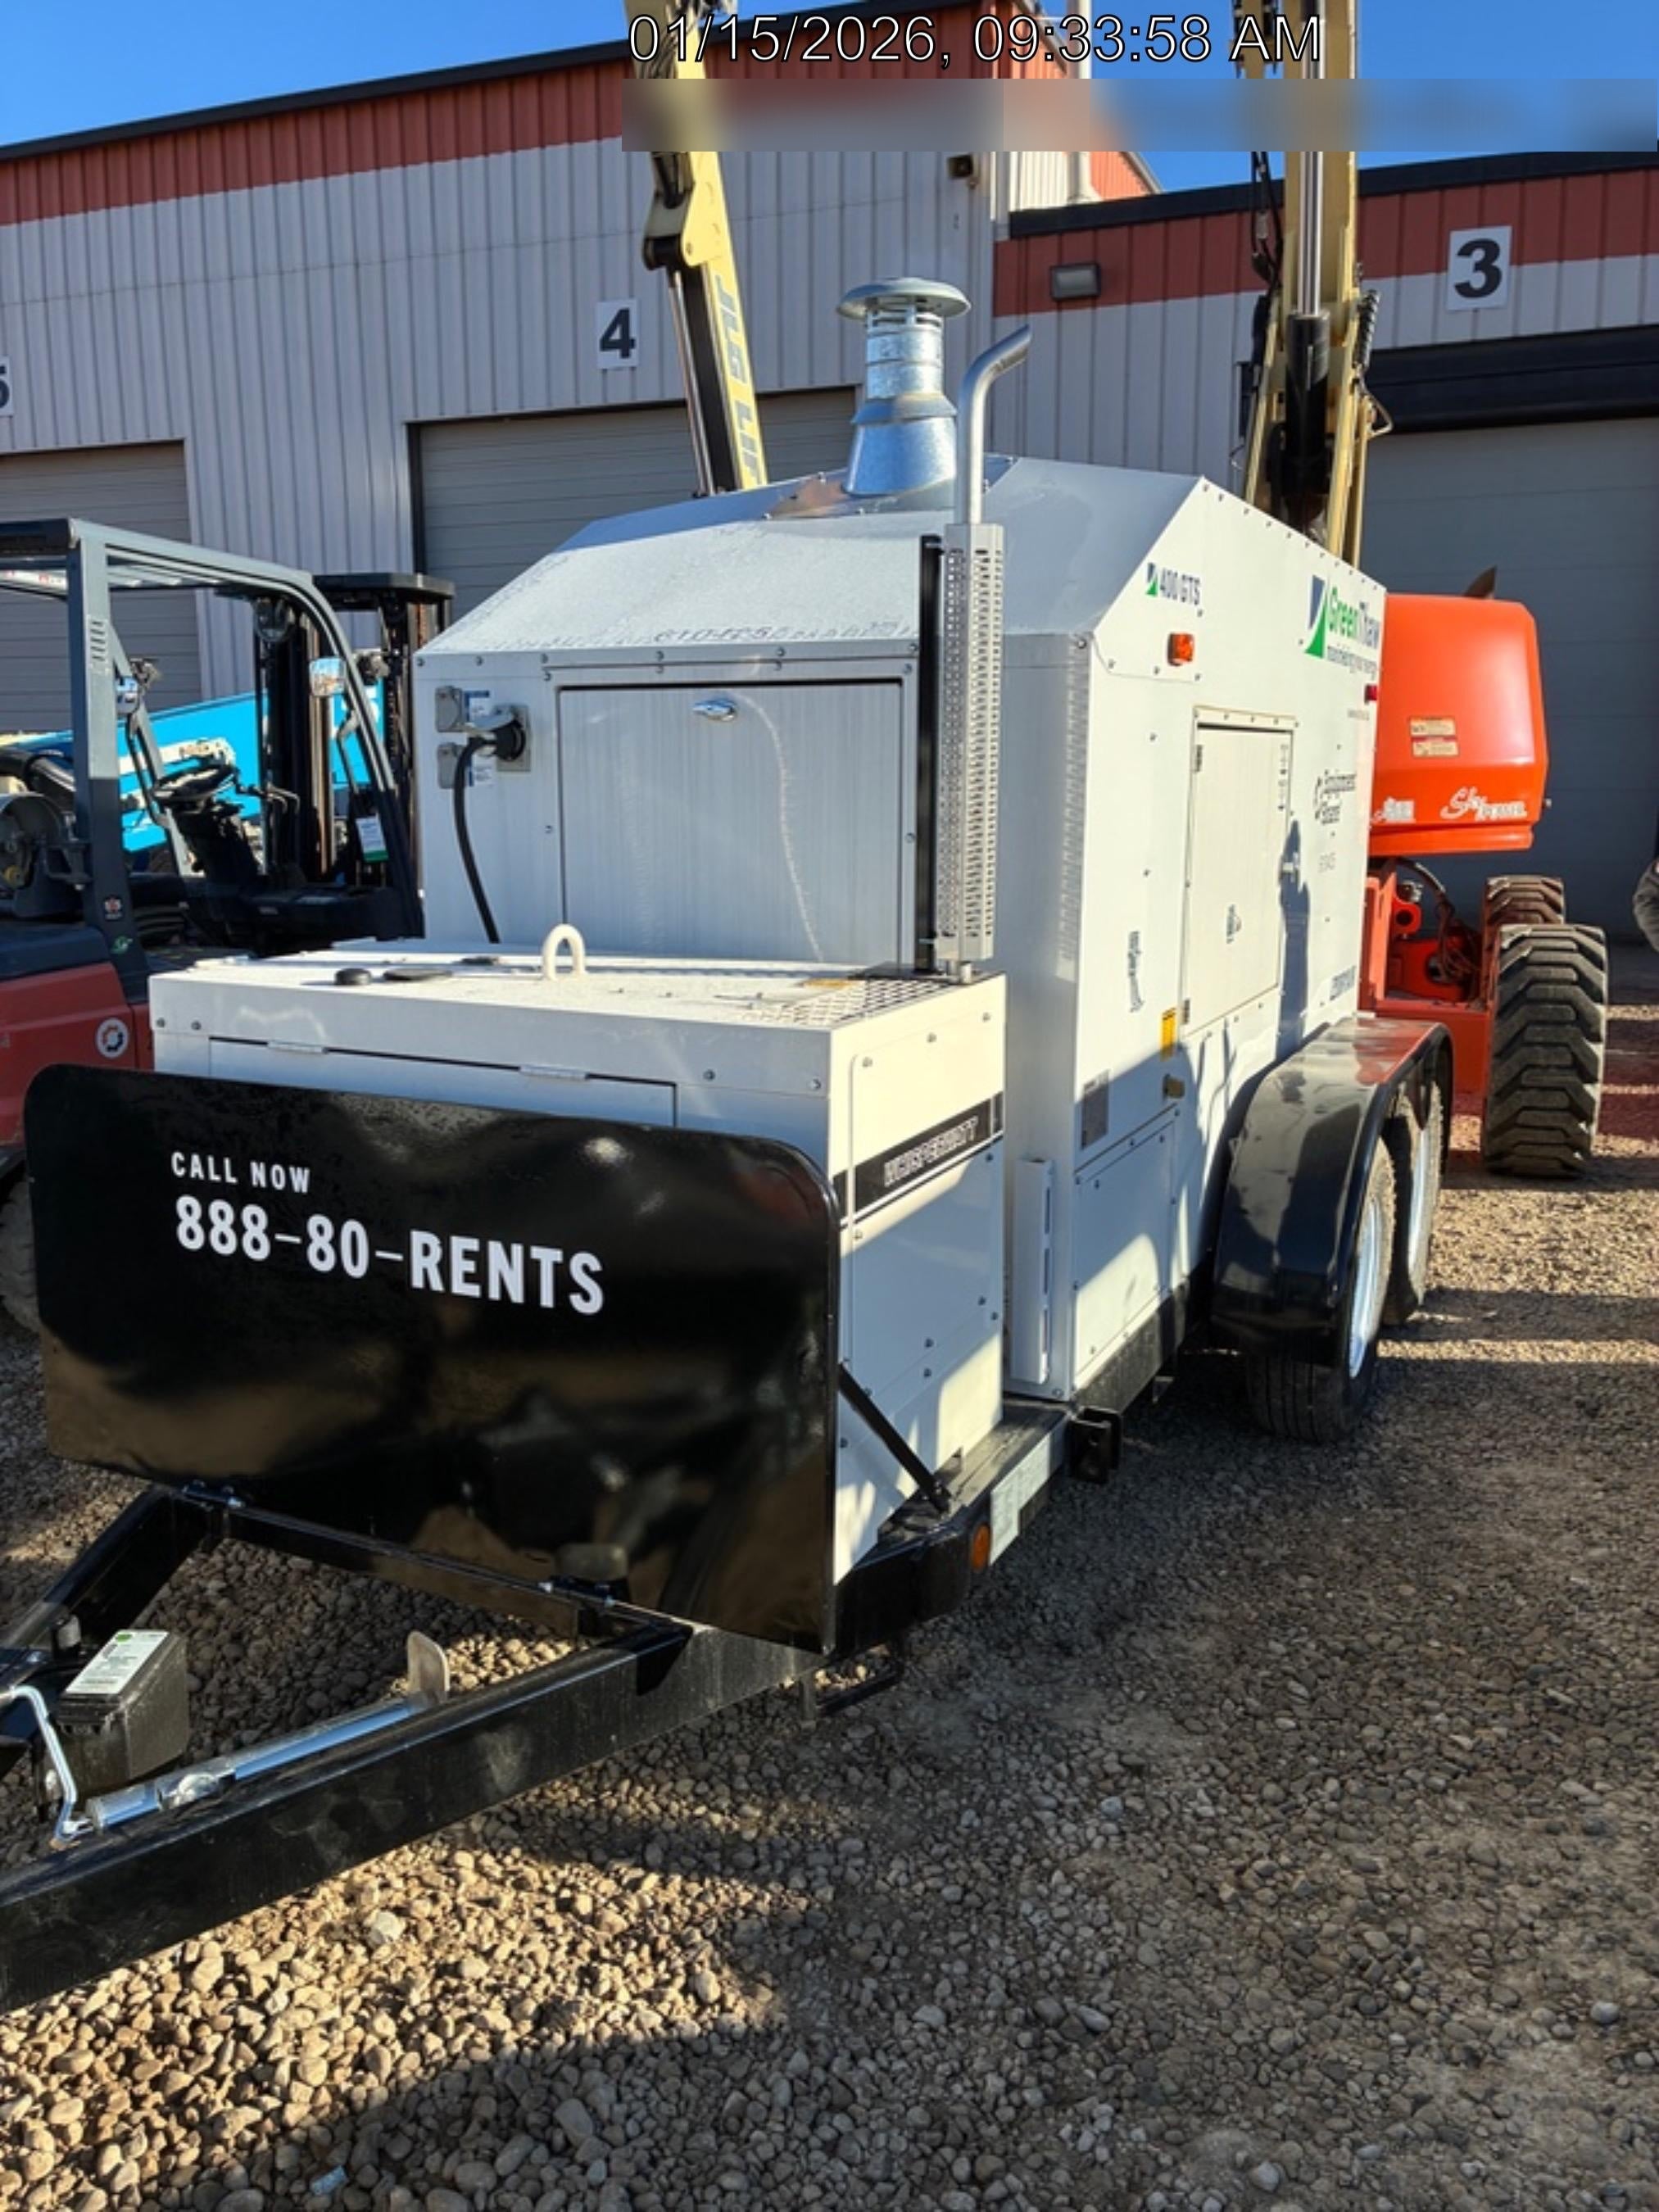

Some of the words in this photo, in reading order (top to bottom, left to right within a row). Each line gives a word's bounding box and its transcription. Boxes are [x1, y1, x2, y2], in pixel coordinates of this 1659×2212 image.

[1453, 238, 1503, 298] 3
[600, 307, 636, 359] 4
[715, 274, 748, 384] JLG
[171, 1151, 238, 1185] CALL
[250, 1161, 310, 1194] NOW
[175, 1194, 605, 1314] 888-80-RENTS
